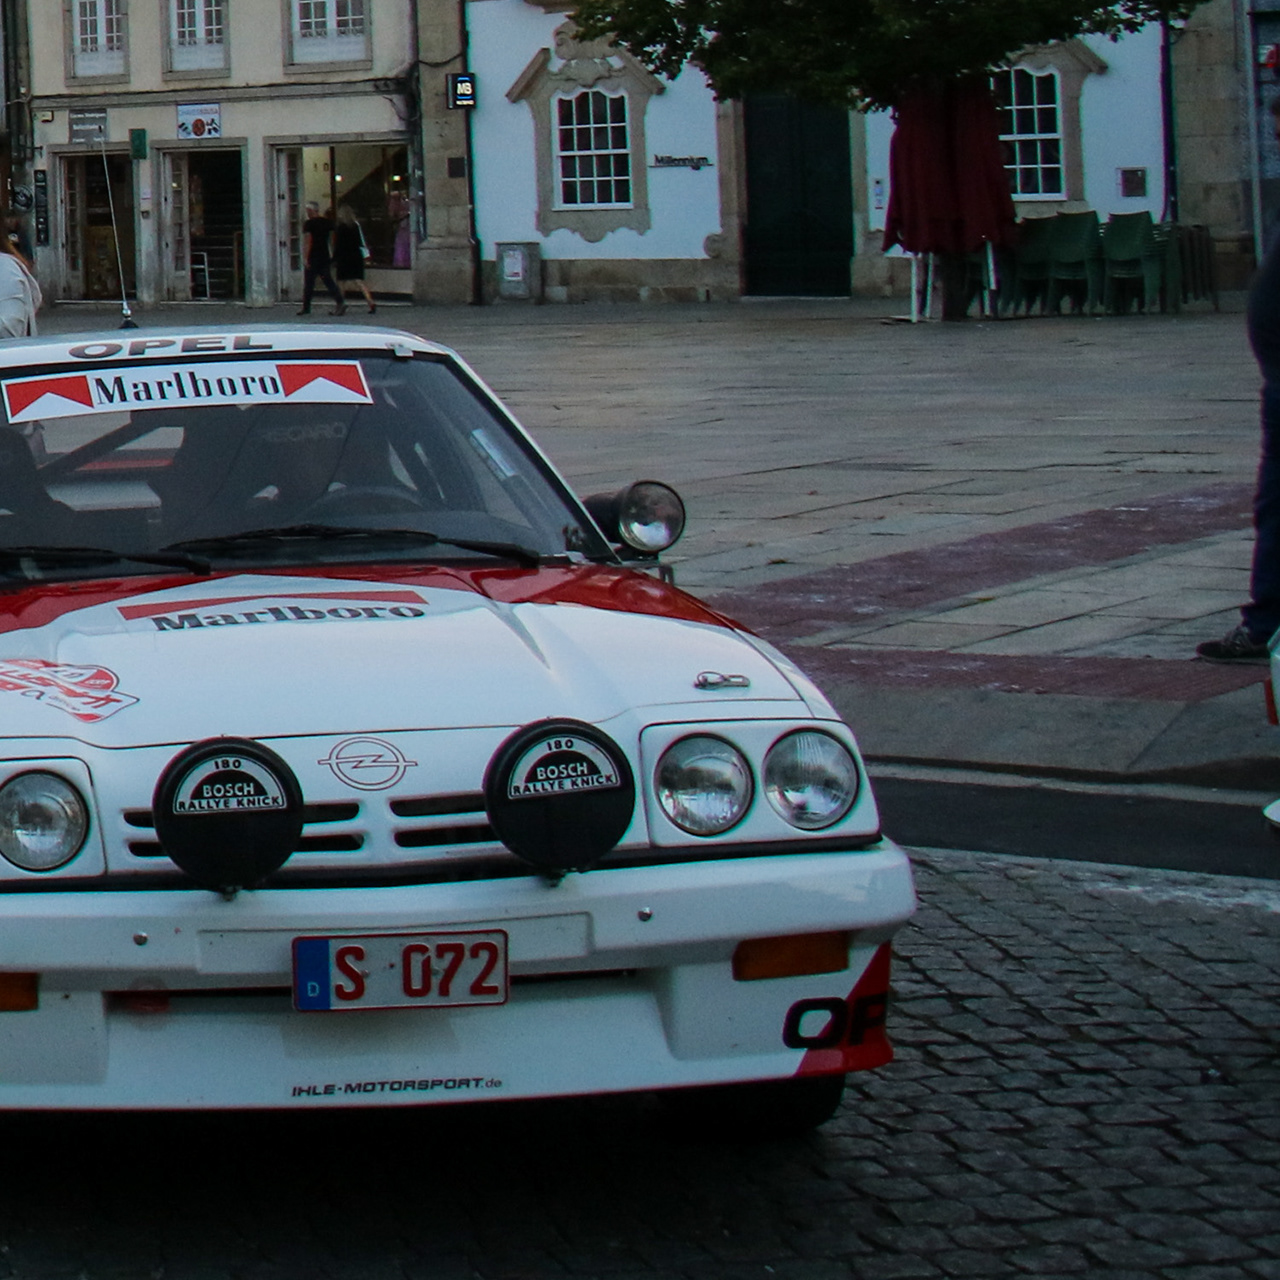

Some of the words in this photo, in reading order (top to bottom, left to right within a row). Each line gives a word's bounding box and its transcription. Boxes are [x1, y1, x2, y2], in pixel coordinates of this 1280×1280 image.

[68, 335, 274, 359] OPEL
[92, 370, 282, 406] Marlboro
[151, 604, 426, 632] Marlboro
[546, 738, 575, 751] 180
[213, 759, 242, 770] 180
[536, 761, 588, 780] BOSCH
[202, 782, 255, 797] BOSCH
[511, 780, 565, 796] RALLYE
[571, 773, 614, 788] KNICK
[178, 799, 231, 811] RALLYE
[236, 796, 280, 808] KNICK
[335, 945, 367, 1001] S
[402, 941, 500, 998] 072
[307, 981, 320, 997] D
